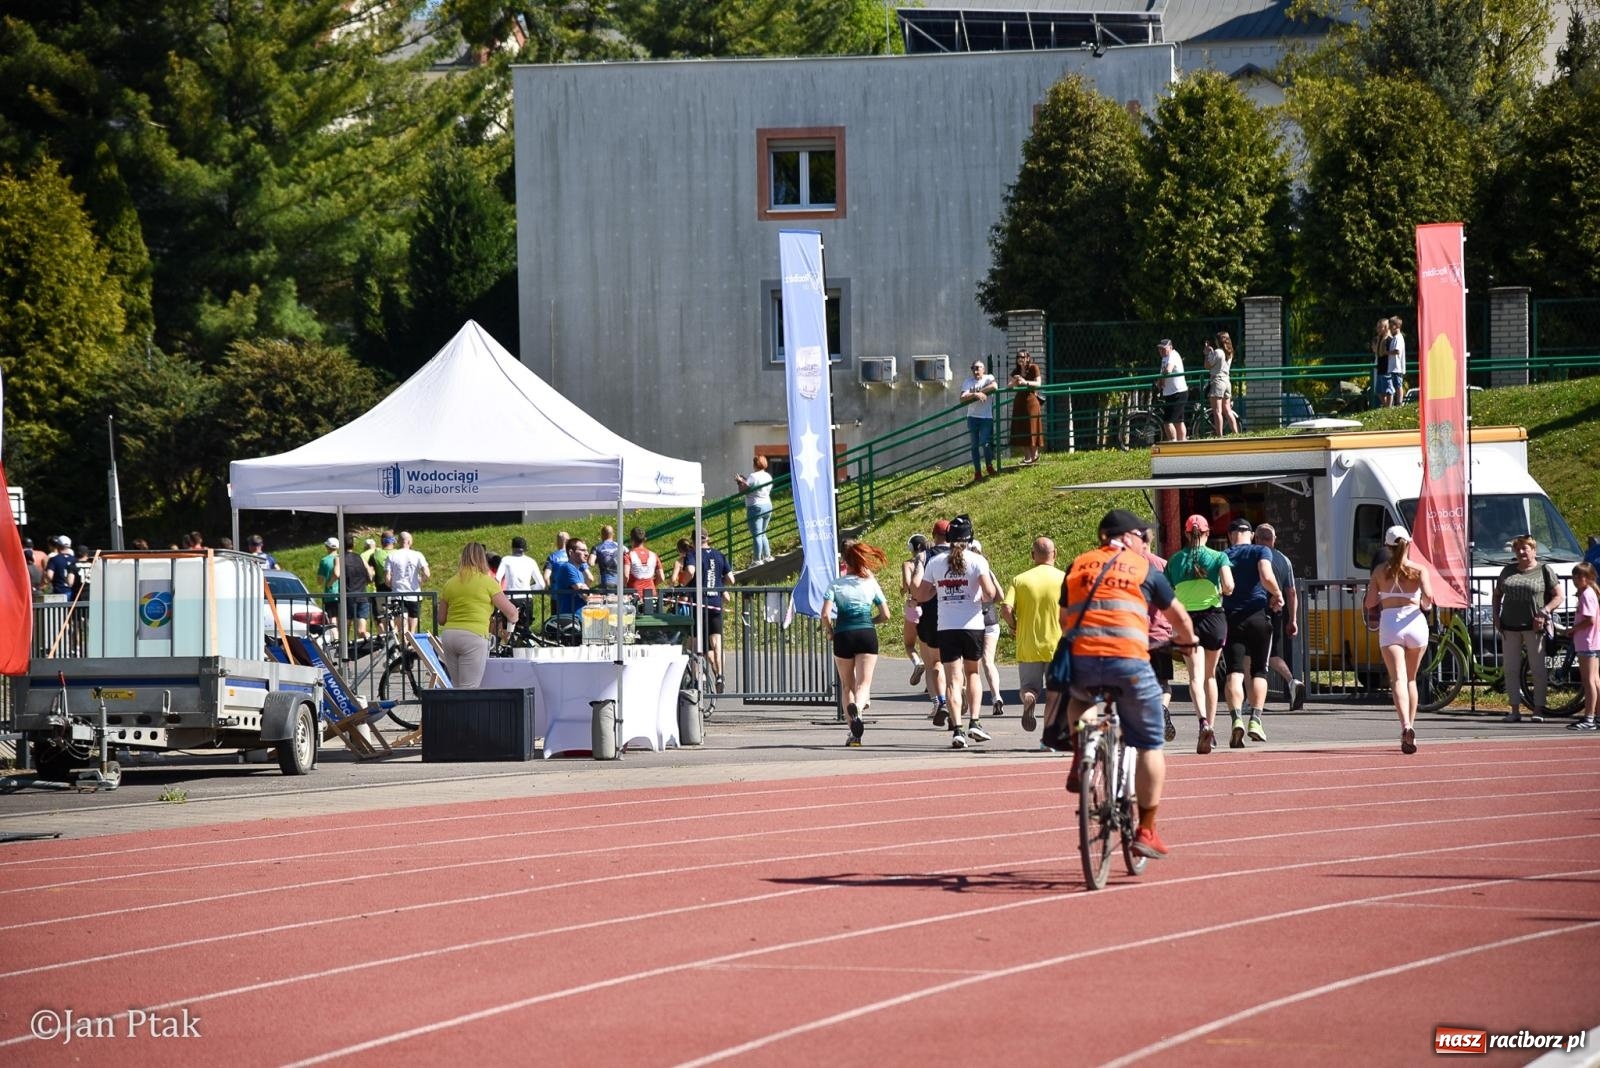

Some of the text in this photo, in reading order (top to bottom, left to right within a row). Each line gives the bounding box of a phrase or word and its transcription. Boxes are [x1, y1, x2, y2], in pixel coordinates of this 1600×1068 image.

[407, 469, 479, 484] Wodociągi
[408, 484, 479, 495] Raciborskie
[1079, 561, 1137, 575] KOIEC
